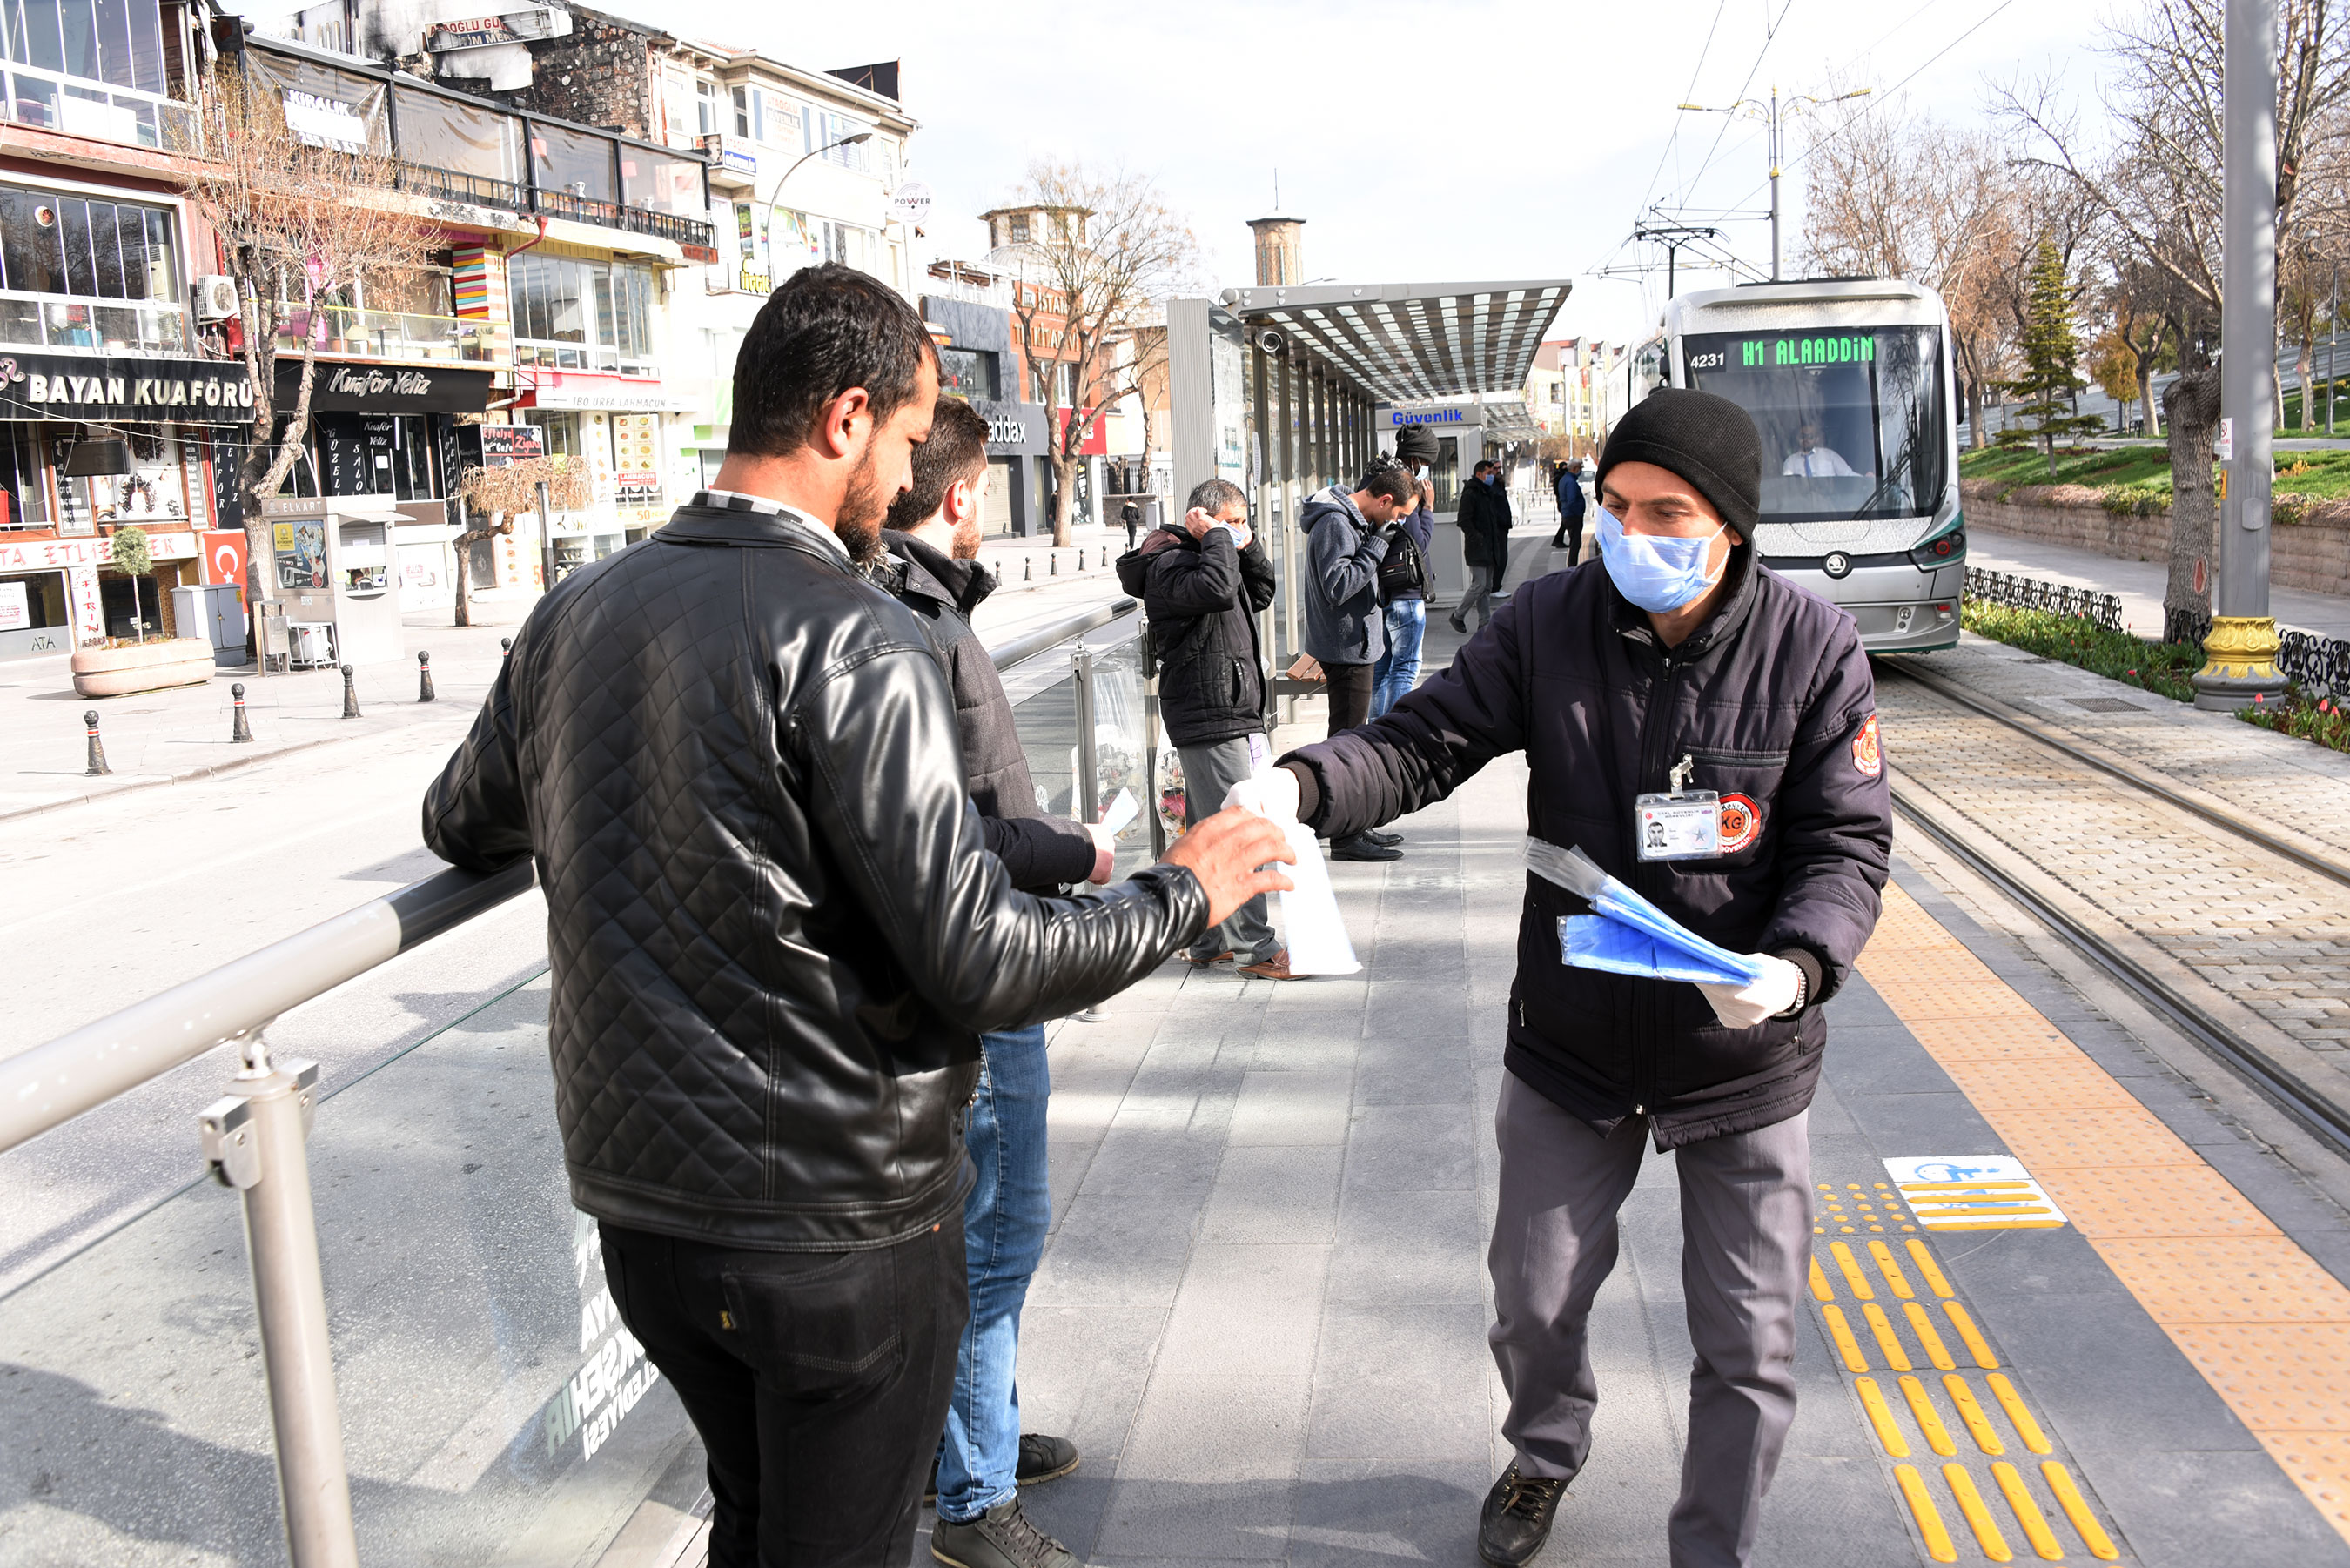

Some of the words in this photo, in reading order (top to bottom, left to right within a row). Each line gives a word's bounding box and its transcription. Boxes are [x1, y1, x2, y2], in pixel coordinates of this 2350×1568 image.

[894, 196, 930, 206] POWER
[1689, 352, 1725, 369] 4231
[1742, 340, 1764, 366] H1
[27, 373, 124, 405] BAYAN
[134, 376, 254, 408] KUAFÖRÜ
[326, 368, 393, 397] Kuaför
[393, 370, 432, 395] Yeliz
[593, 397, 615, 407] URFA
[619, 398, 667, 408] LAHMACUN
[1392, 409, 1464, 425] Güvenlik
[364, 421, 393, 432] Kuaför
[987, 414, 1027, 444] addax
[369, 436, 388, 446] Yeliz
[352, 444, 365, 495] SALO
[282, 501, 323, 513] ELKART
[636, 509, 651, 520] 50
[31, 635, 57, 652] ATA
